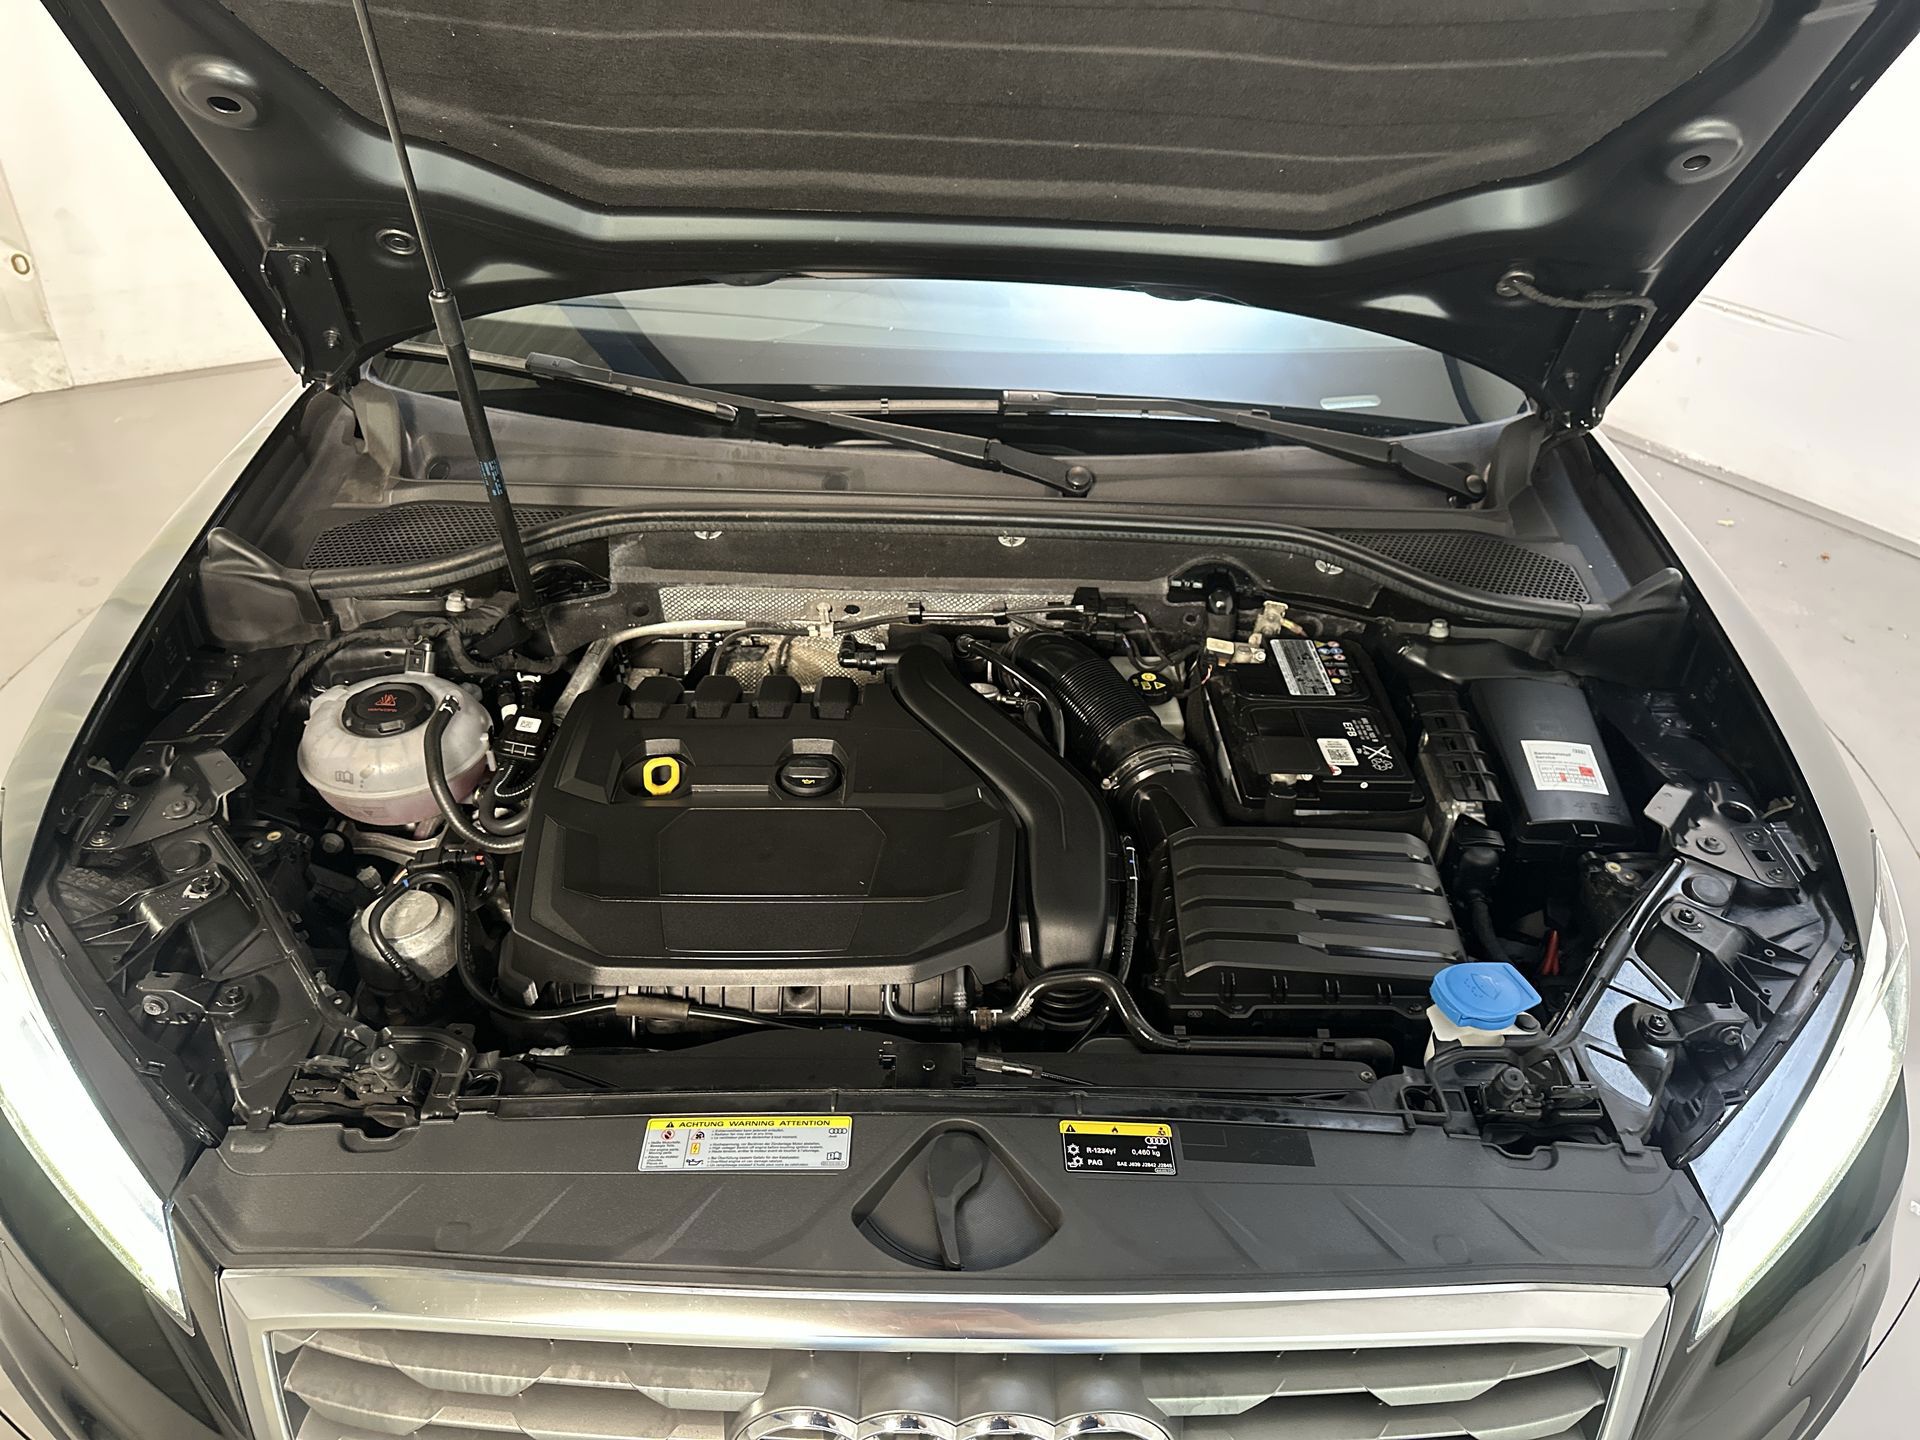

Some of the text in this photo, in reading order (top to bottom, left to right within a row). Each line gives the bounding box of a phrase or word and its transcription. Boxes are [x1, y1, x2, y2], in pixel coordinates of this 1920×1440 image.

[1342, 722, 1358, 737] EFB
[1086, 1147, 1117, 1155] R-1234yf
[1152, 1149, 1160, 1157] kg
